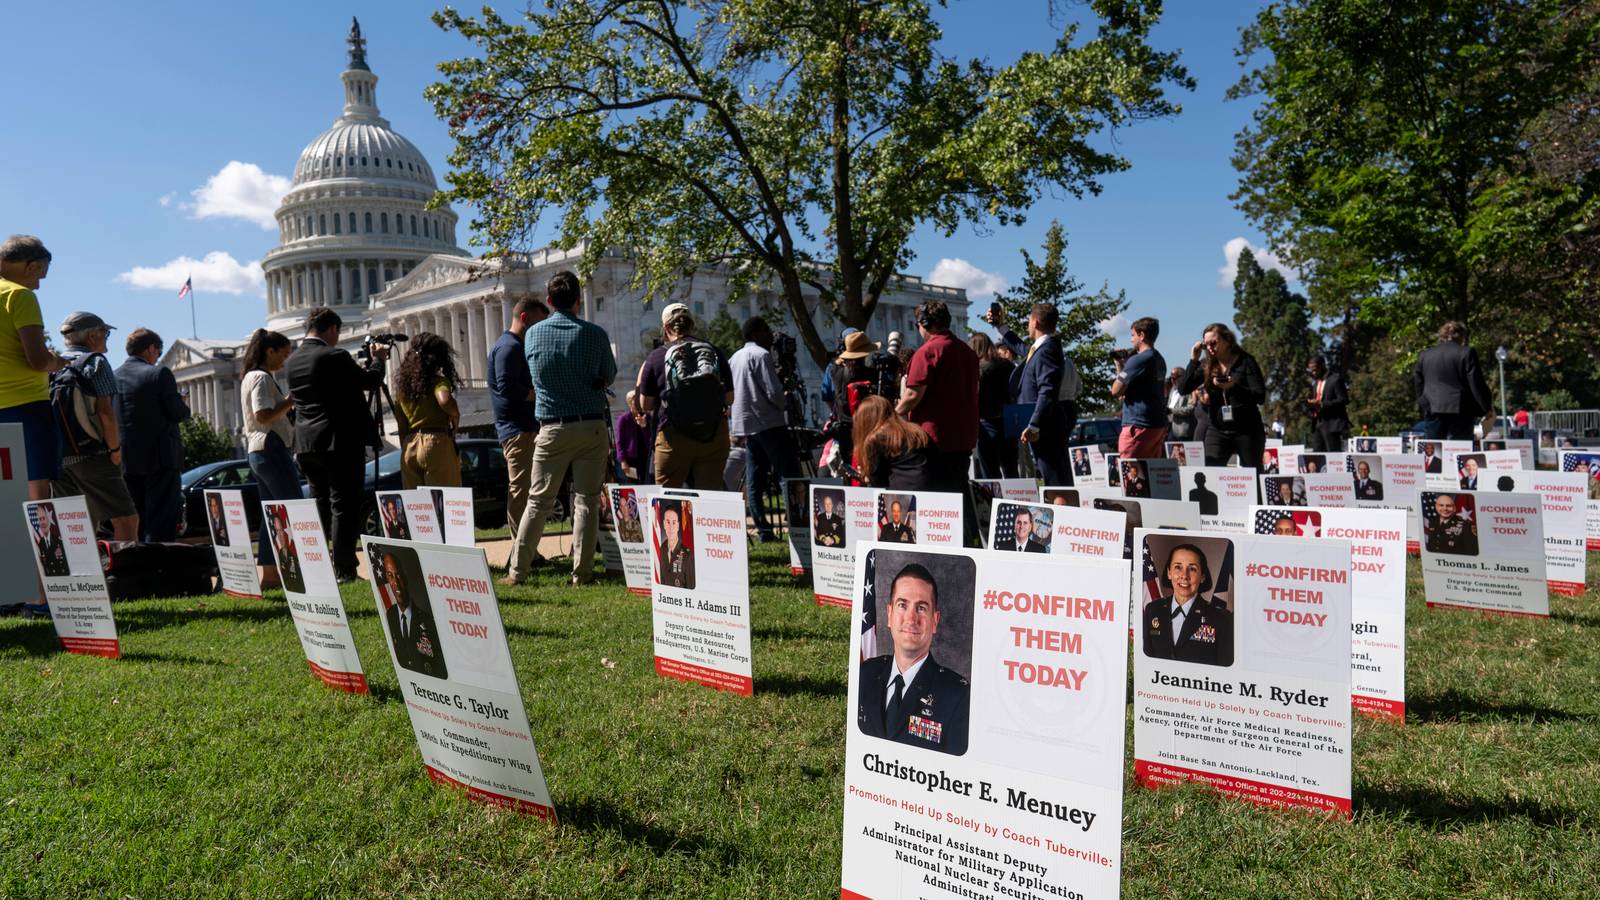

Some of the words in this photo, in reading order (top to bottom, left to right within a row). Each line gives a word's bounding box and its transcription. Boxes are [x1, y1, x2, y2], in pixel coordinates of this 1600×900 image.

[918, 510, 960, 519] #CONFIRM
[1480, 506, 1537, 514] #CONFIRM
[1543, 504, 1574, 512] TODAY
[696, 516, 742, 529] #CONFIRM
[928, 522, 950, 530] THEM
[1494, 516, 1525, 524] THEM
[706, 534, 732, 544] THEM
[926, 534, 952, 542] TODAY
[1058, 525, 1120, 542] #CONFIRM
[1327, 527, 1400, 541] #CONFIRM
[1492, 527, 1528, 535] TODAY
[705, 548, 734, 560] TODAY
[818, 552, 842, 561] Michael
[1070, 542, 1105, 556] THEM
[1351, 546, 1383, 557] HEM
[1246, 564, 1347, 584] #CONFIRM
[1436, 558, 1478, 570] Thomas
[1481, 562, 1491, 571] L.
[1494, 564, 1530, 574] James
[77, 582, 105, 593] McQueen
[428, 574, 489, 594] #CONFIRM
[1448, 578, 1472, 586] Deputy
[1474, 581, 1520, 590] Commander,
[1485, 588, 1522, 596] Command
[658, 593, 682, 606] James
[685, 598, 694, 608] H.
[697, 600, 727, 614] Adams
[730, 604, 741, 616] III
[1268, 587, 1324, 604] THEM
[316, 603, 340, 618] Rohling
[446, 598, 481, 616] THEM
[983, 590, 1115, 622] #CONFIRM
[1264, 608, 1328, 628] TODAY
[449, 620, 488, 640] TODAY
[666, 621, 684, 632] Deputy
[686, 626, 724, 639] Commandant
[725, 632, 734, 641] for
[1010, 626, 1082, 654] THEM
[656, 636, 693, 651] Headquarters,
[694, 645, 706, 654] U.S.
[707, 648, 729, 660] Marine
[730, 652, 749, 664] Corps
[664, 630, 690, 642] Programs
[692, 636, 702, 644] and
[704, 638, 736, 652] Resources,
[1004, 660, 1088, 691] TODAY
[1152, 670, 1233, 694] Jeannine
[1239, 682, 1263, 699] M.
[1270, 686, 1329, 708] Ryder
[1356, 684, 1388, 695] Germany
[410, 682, 451, 706] Terence
[454, 694, 466, 710] G.
[468, 698, 510, 720] Taylor
[1138, 690, 1180, 704] Promotion
[1182, 696, 1201, 706] Held
[1204, 699, 1216, 710] Up
[1220, 702, 1246, 714] Solely
[1249, 706, 1260, 716] by
[1263, 708, 1292, 720] Coach
[1296, 714, 1346, 729] Tuberville:
[477, 722, 496, 733] Coach
[1139, 714, 1171, 727] Agency,
[1173, 720, 1200, 731] Office
[1202, 724, 1211, 733] of
[1214, 726, 1229, 736] the
[1232, 730, 1270, 743] Surgeon
[1273, 736, 1311, 749] General
[1314, 743, 1325, 752] of
[1328, 744, 1344, 755] the
[1144, 706, 1197, 722] Commander,
[1200, 714, 1213, 724] Air
[1217, 718, 1241, 728] Force
[1244, 722, 1281, 734] Medical
[1284, 728, 1336, 744] Readiness,
[442, 728, 491, 750] Commander,
[1174, 729, 1225, 744] Department
[1228, 736, 1238, 746] of
[1240, 738, 1256, 748] the
[1259, 742, 1273, 752] Air
[1276, 746, 1302, 757] Force
[420, 730, 438, 745] 380th
[440, 738, 450, 749] Air
[452, 742, 506, 768] Expeditionary
[508, 758, 532, 774] Wing
[1148, 764, 1162, 774] Call
[1163, 766, 1191, 779] Senator
[1192, 772, 1234, 787] Tuberville's
[1235, 781, 1258, 792] Office
[1158, 750, 1178, 760] Joint
[1180, 754, 1199, 764] Base
[1202, 758, 1217, 768] San
[1220, 761, 1299, 784] Antonio-Lackland,
[1301, 776, 1320, 787] Tex.
[508, 784, 536, 797] Emirates
[862, 753, 973, 797] Christopher
[979, 781, 998, 804] E.
[1006, 788, 1097, 832] Menuey
[849, 785, 898, 808] Promotion
[901, 800, 924, 815] Held
[928, 808, 942, 820] Up
[946, 812, 980, 832] Solely
[984, 822, 998, 838] by
[1002, 828, 1040, 848] Coach
[1045, 838, 1113, 868] Tuberville:
[894, 821, 943, 844] Principal
[946, 838, 1000, 862] Assistant
[1004, 854, 1048, 878] Deputy
[862, 826, 935, 856] Administrator
[938, 848, 955, 862] for
[958, 856, 1006, 880] Military
[1010, 871, 1084, 900] Application
[895, 850, 941, 874] National
[944, 865, 990, 889] Nuclear
